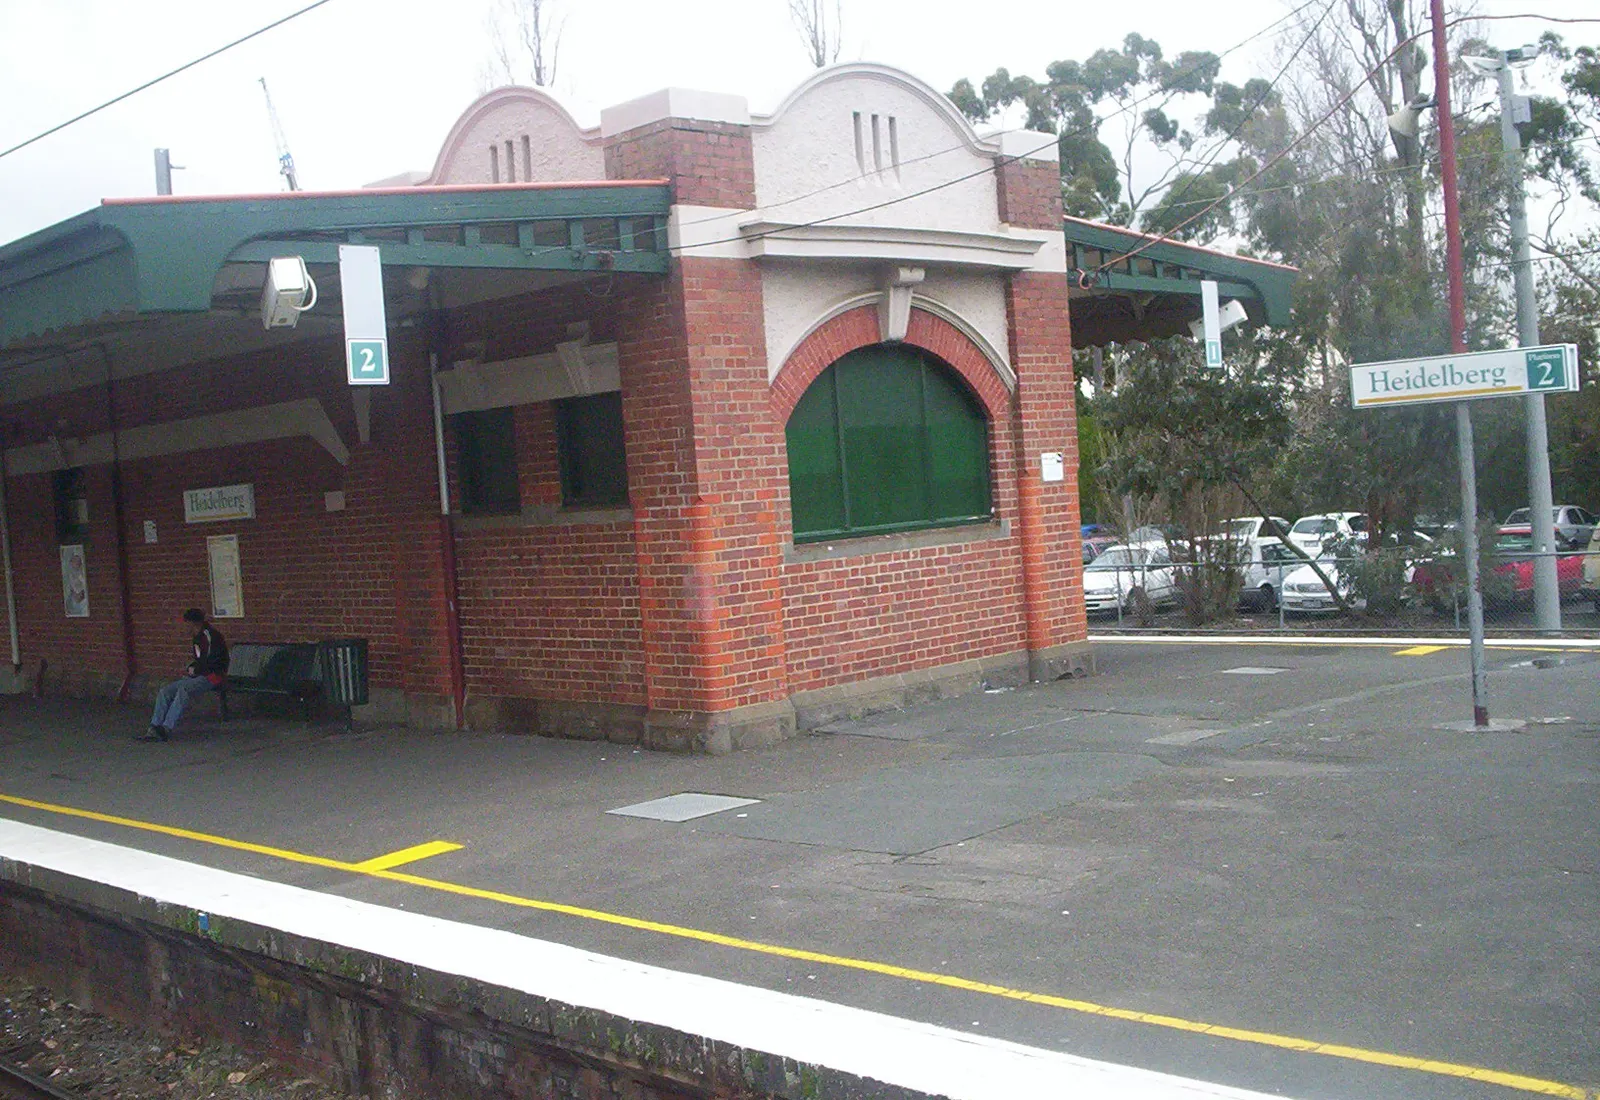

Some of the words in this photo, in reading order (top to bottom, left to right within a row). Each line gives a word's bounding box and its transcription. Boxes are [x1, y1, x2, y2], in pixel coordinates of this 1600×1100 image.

[359, 347, 376, 372] 2
[1211, 344, 1217, 361] 1
[1368, 363, 1507, 394] Heidelberg
[1536, 361, 1556, 386] 2
